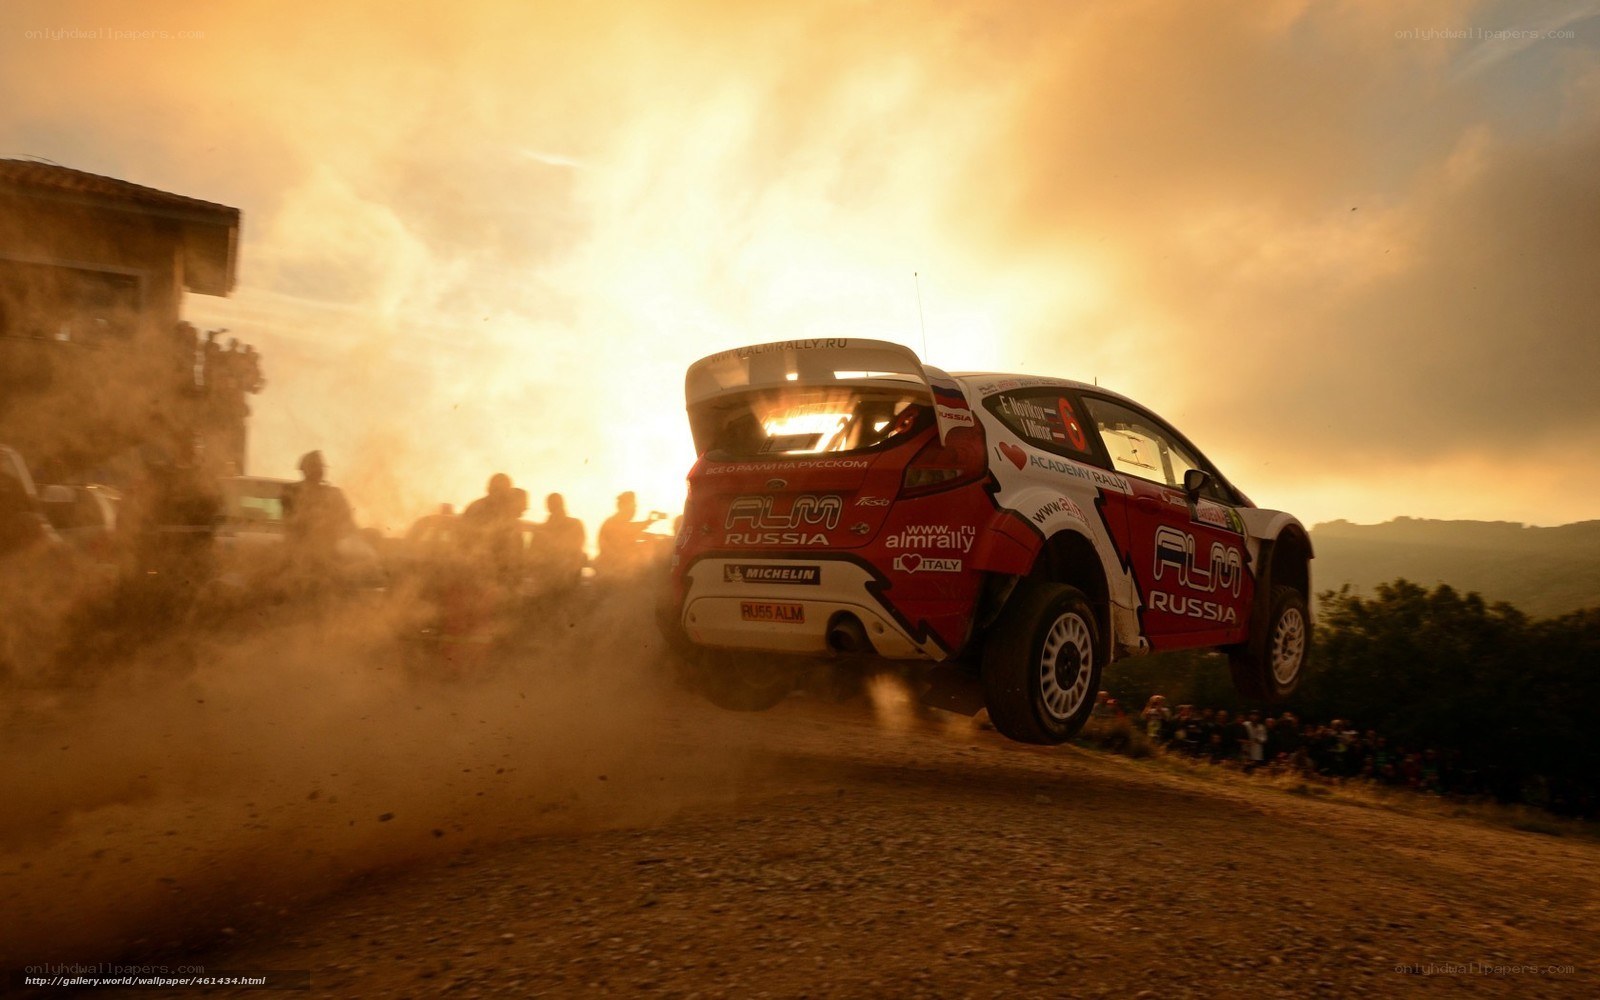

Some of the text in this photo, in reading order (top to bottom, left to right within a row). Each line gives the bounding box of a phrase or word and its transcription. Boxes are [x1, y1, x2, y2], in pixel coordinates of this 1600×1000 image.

[1030, 454, 1091, 480] ACADEMY
[1092, 471, 1129, 492] RALLY
[724, 495, 843, 530] ALM
[725, 533, 830, 545] RUSSIA
[906, 525, 976, 535] www. ru
[885, 531, 974, 553] almrally
[922, 560, 960, 570] ITALY
[1153, 525, 1242, 598] ALM
[745, 568, 815, 580] MICHELIN
[775, 605, 804, 621] ALM
[1149, 590, 1237, 624] RUSSIA
